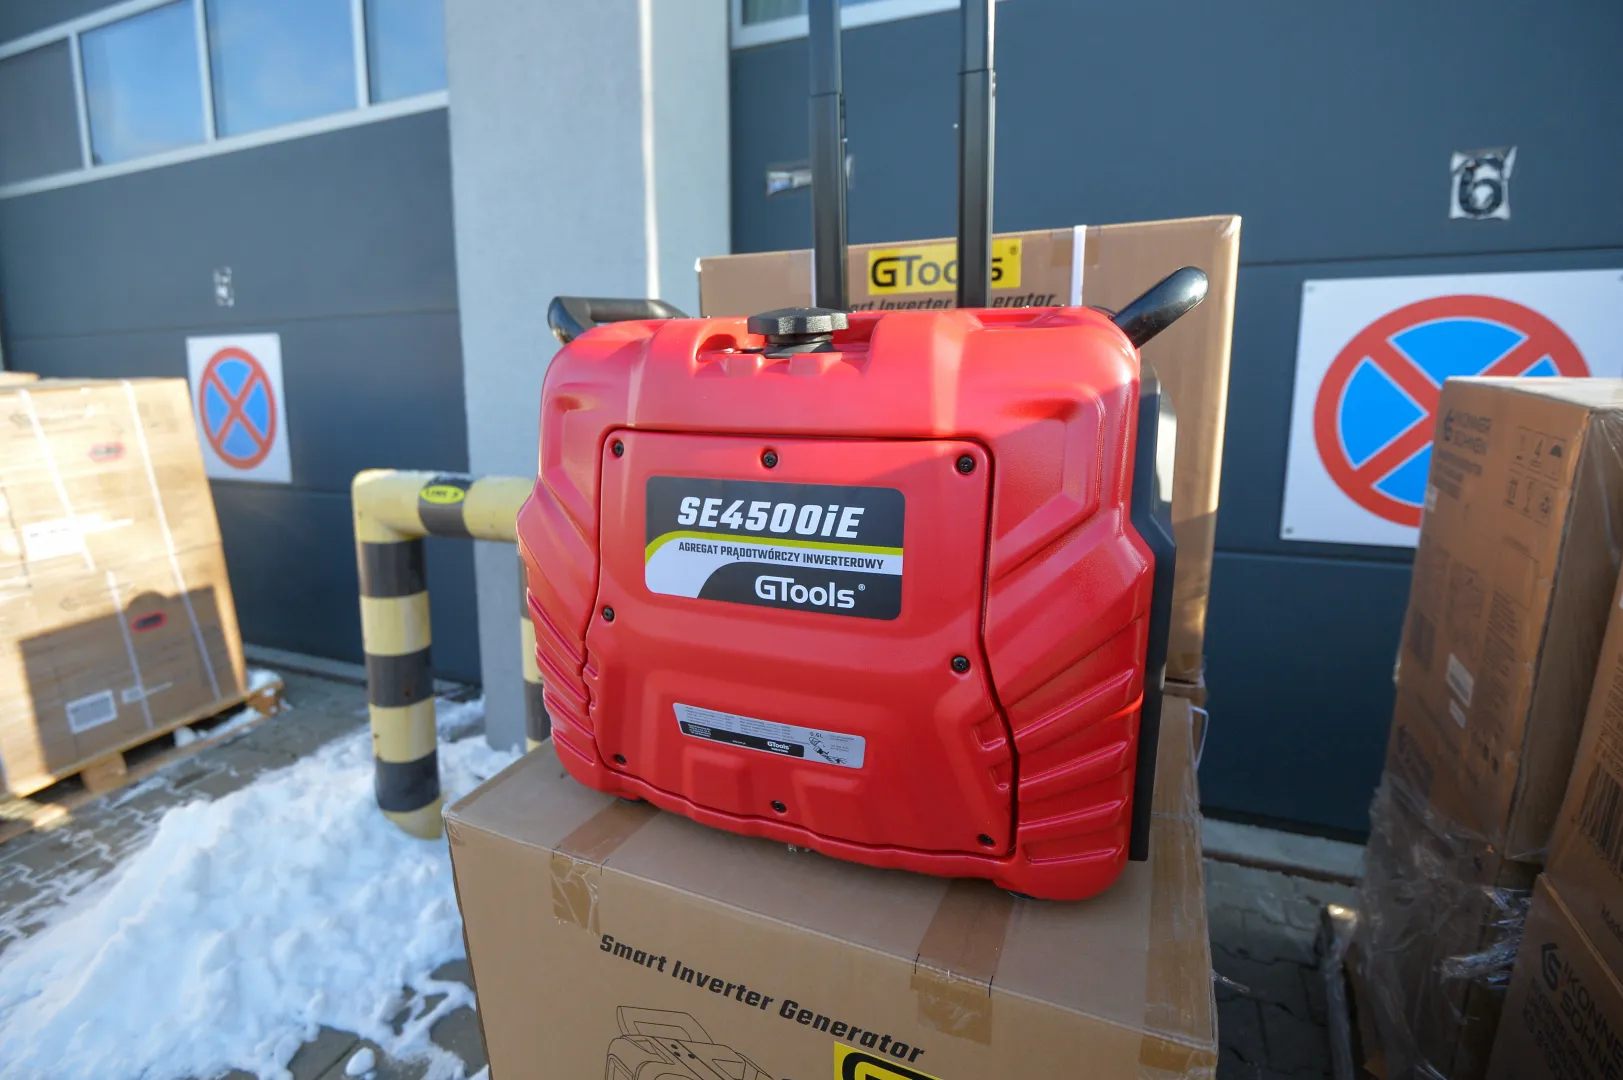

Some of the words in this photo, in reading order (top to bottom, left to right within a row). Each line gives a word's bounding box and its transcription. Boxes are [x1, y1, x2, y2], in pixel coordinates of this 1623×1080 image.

[1460, 157, 1503, 215] 6
[677, 496, 865, 539] SE4500iE
[679, 541, 719, 556] AGREGAT
[720, 546, 800, 563] PRĄDOTWÓRCZY
[802, 553, 884, 570] INWERTEROWY
[755, 575, 855, 609] GTools
[766, 741, 790, 750] GTools
[600, 934, 667, 973] Smart
[671, 960, 774, 1011] Inverter
[779, 999, 925, 1063] Generator
